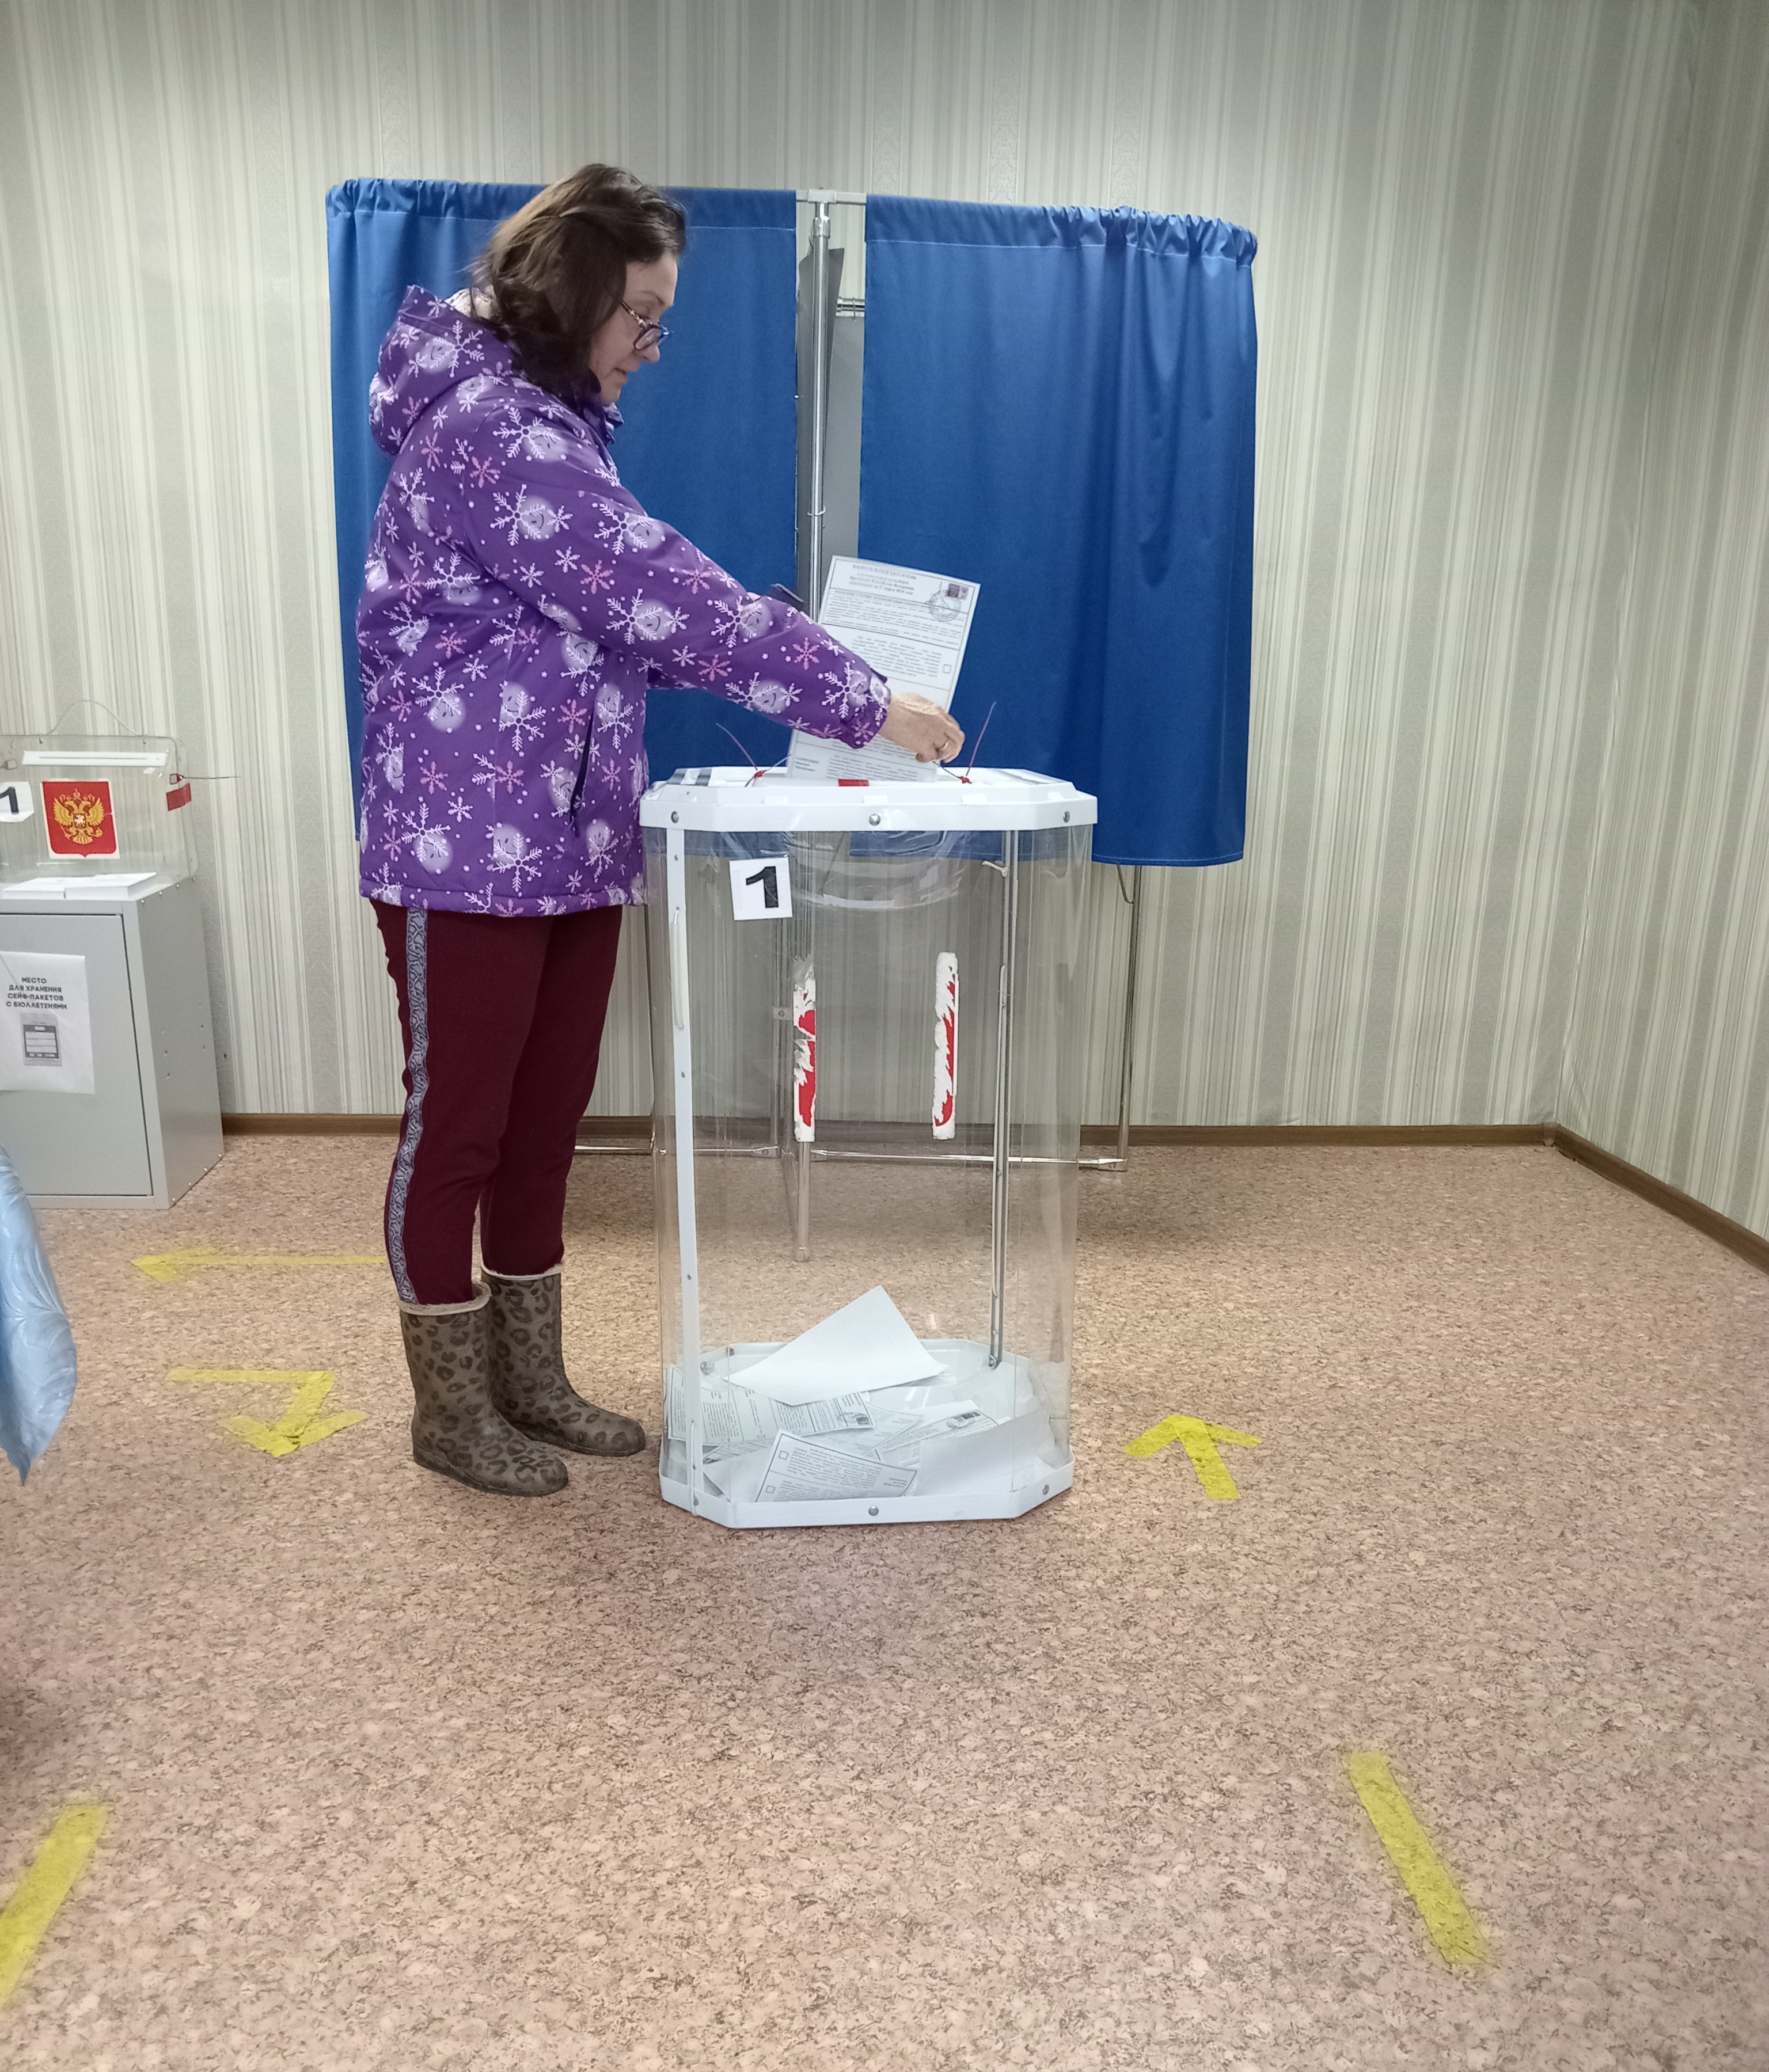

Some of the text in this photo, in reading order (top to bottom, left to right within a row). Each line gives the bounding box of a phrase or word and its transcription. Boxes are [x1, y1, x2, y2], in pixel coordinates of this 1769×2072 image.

[0, 786, 19, 815] 1
[746, 866, 779, 908] 1
[7, 993, 63, 1001] СЕЙФ-ПАКЕТОВ
